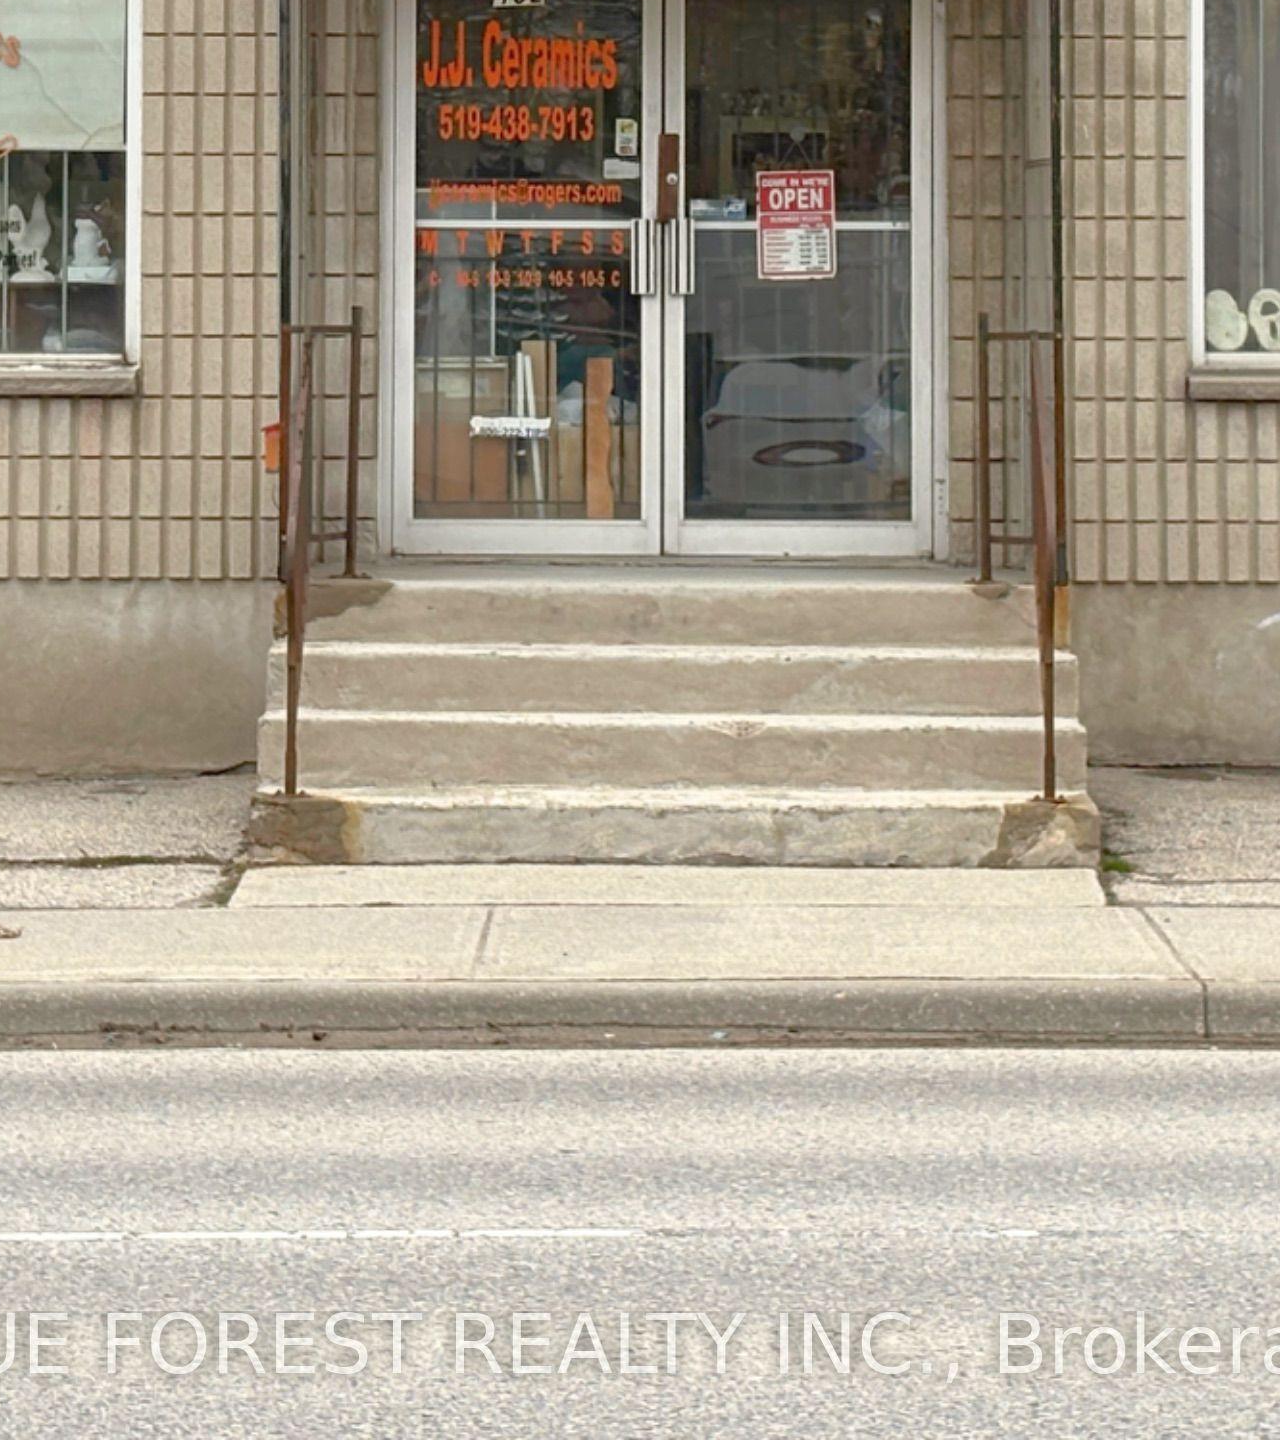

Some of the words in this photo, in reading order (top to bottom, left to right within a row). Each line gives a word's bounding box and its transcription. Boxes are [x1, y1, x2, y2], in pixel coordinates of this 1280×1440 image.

[423, 20, 473, 88] J.J.
[482, 20, 617, 89] Ceramics
[439, 104, 594, 140] 519-438-7913
[769, 188, 824, 210] OPEN
[421, 230, 438, 254] M
[455, 230, 469, 253] T
[486, 231, 505, 256] W
[521, 231, 537, 254] T
[552, 231, 564, 254] F
[582, 230, 594, 254] S
[612, 230, 624, 254] S
